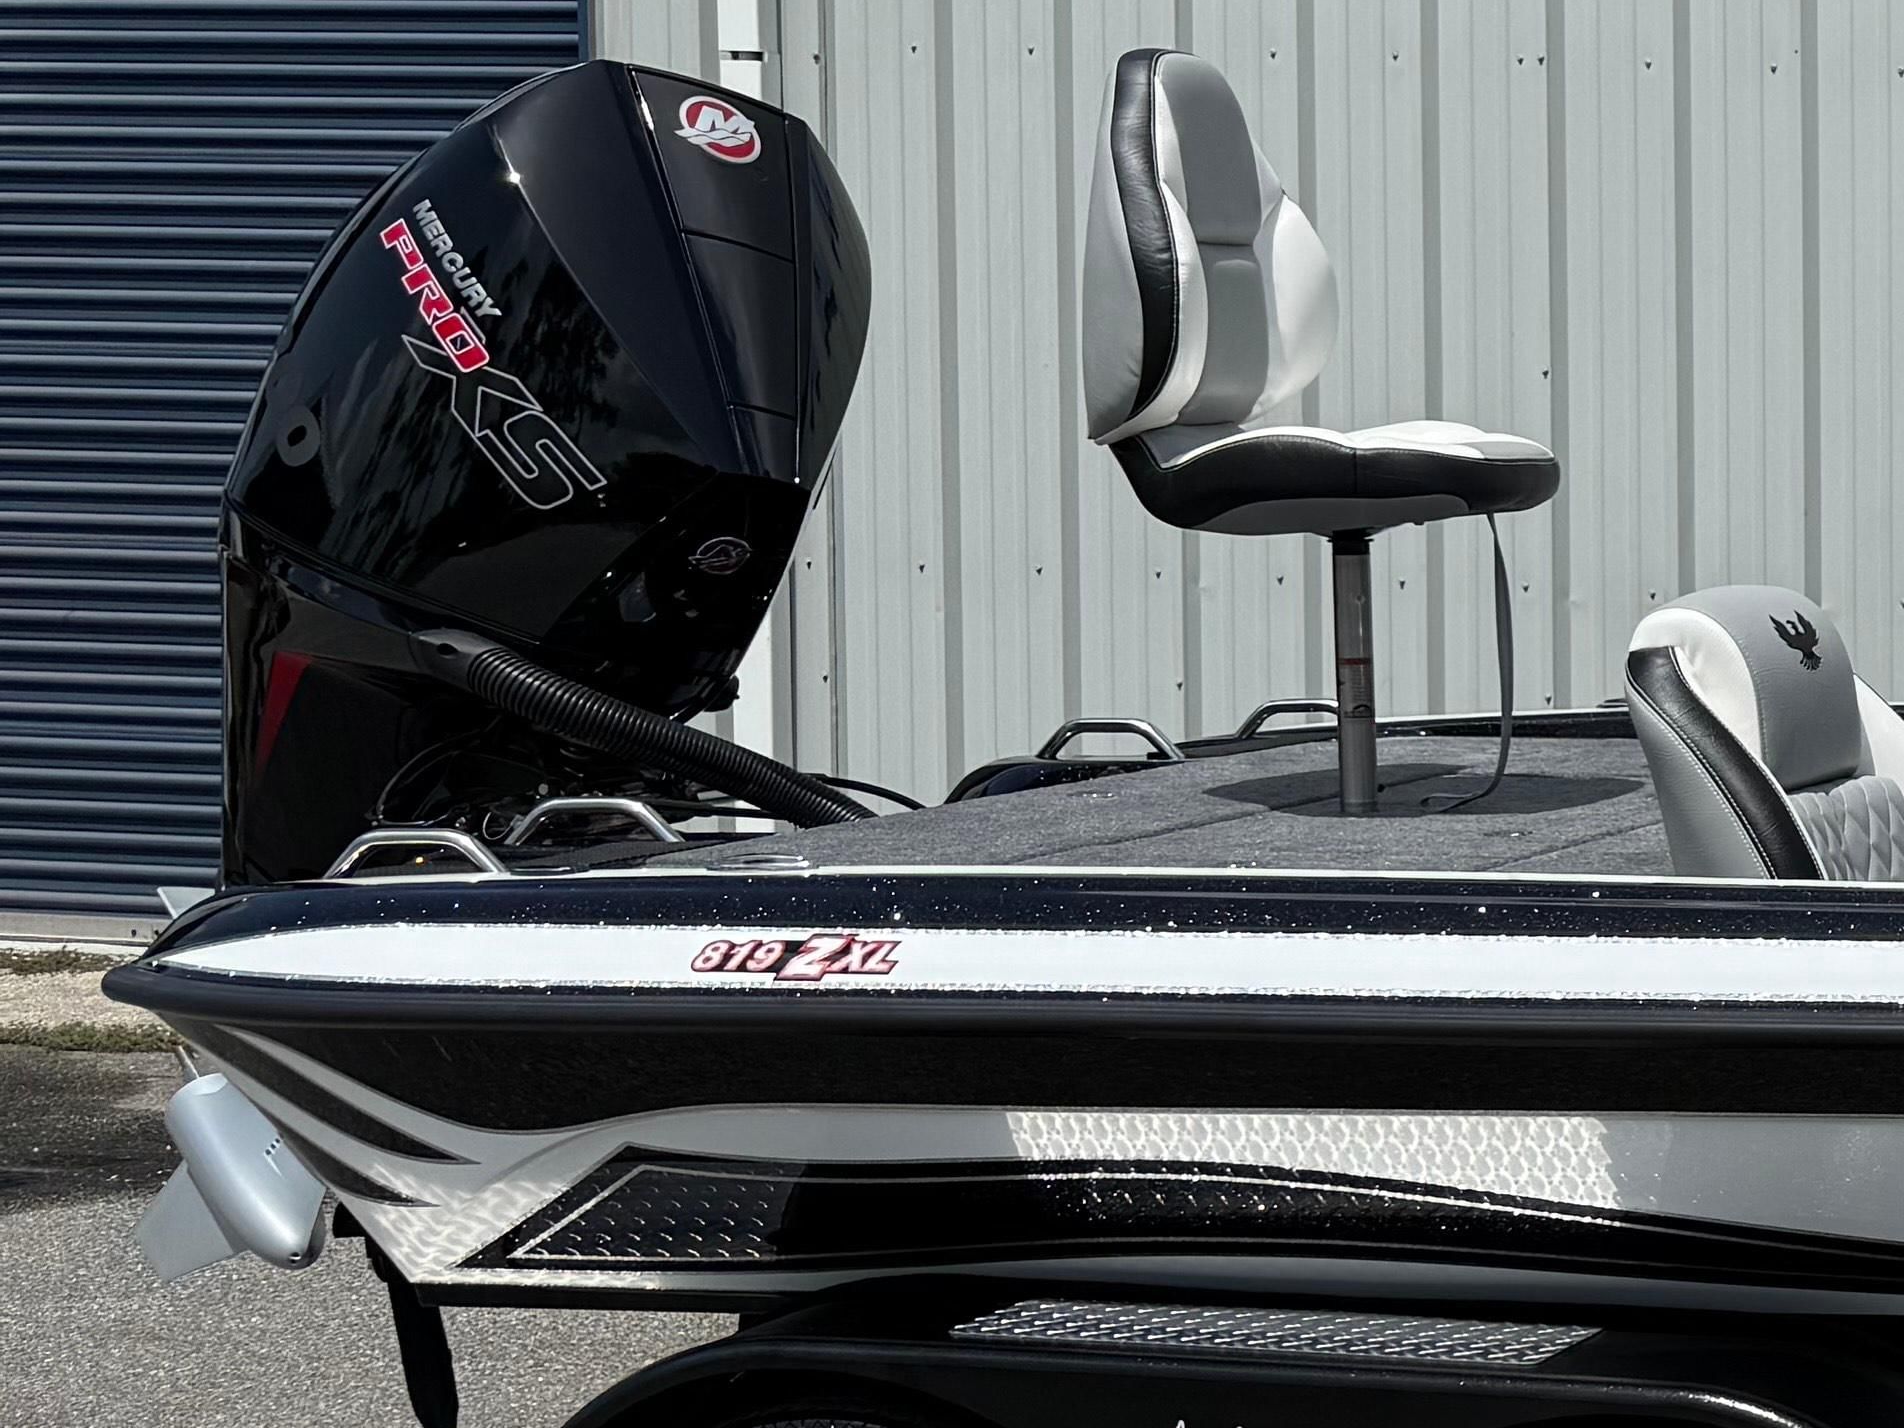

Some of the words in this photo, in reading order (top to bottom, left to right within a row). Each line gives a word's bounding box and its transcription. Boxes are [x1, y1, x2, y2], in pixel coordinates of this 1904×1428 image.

[379, 218, 489, 373] PRO
[412, 198, 503, 318] MERCURY
[401, 306, 607, 510] XS
